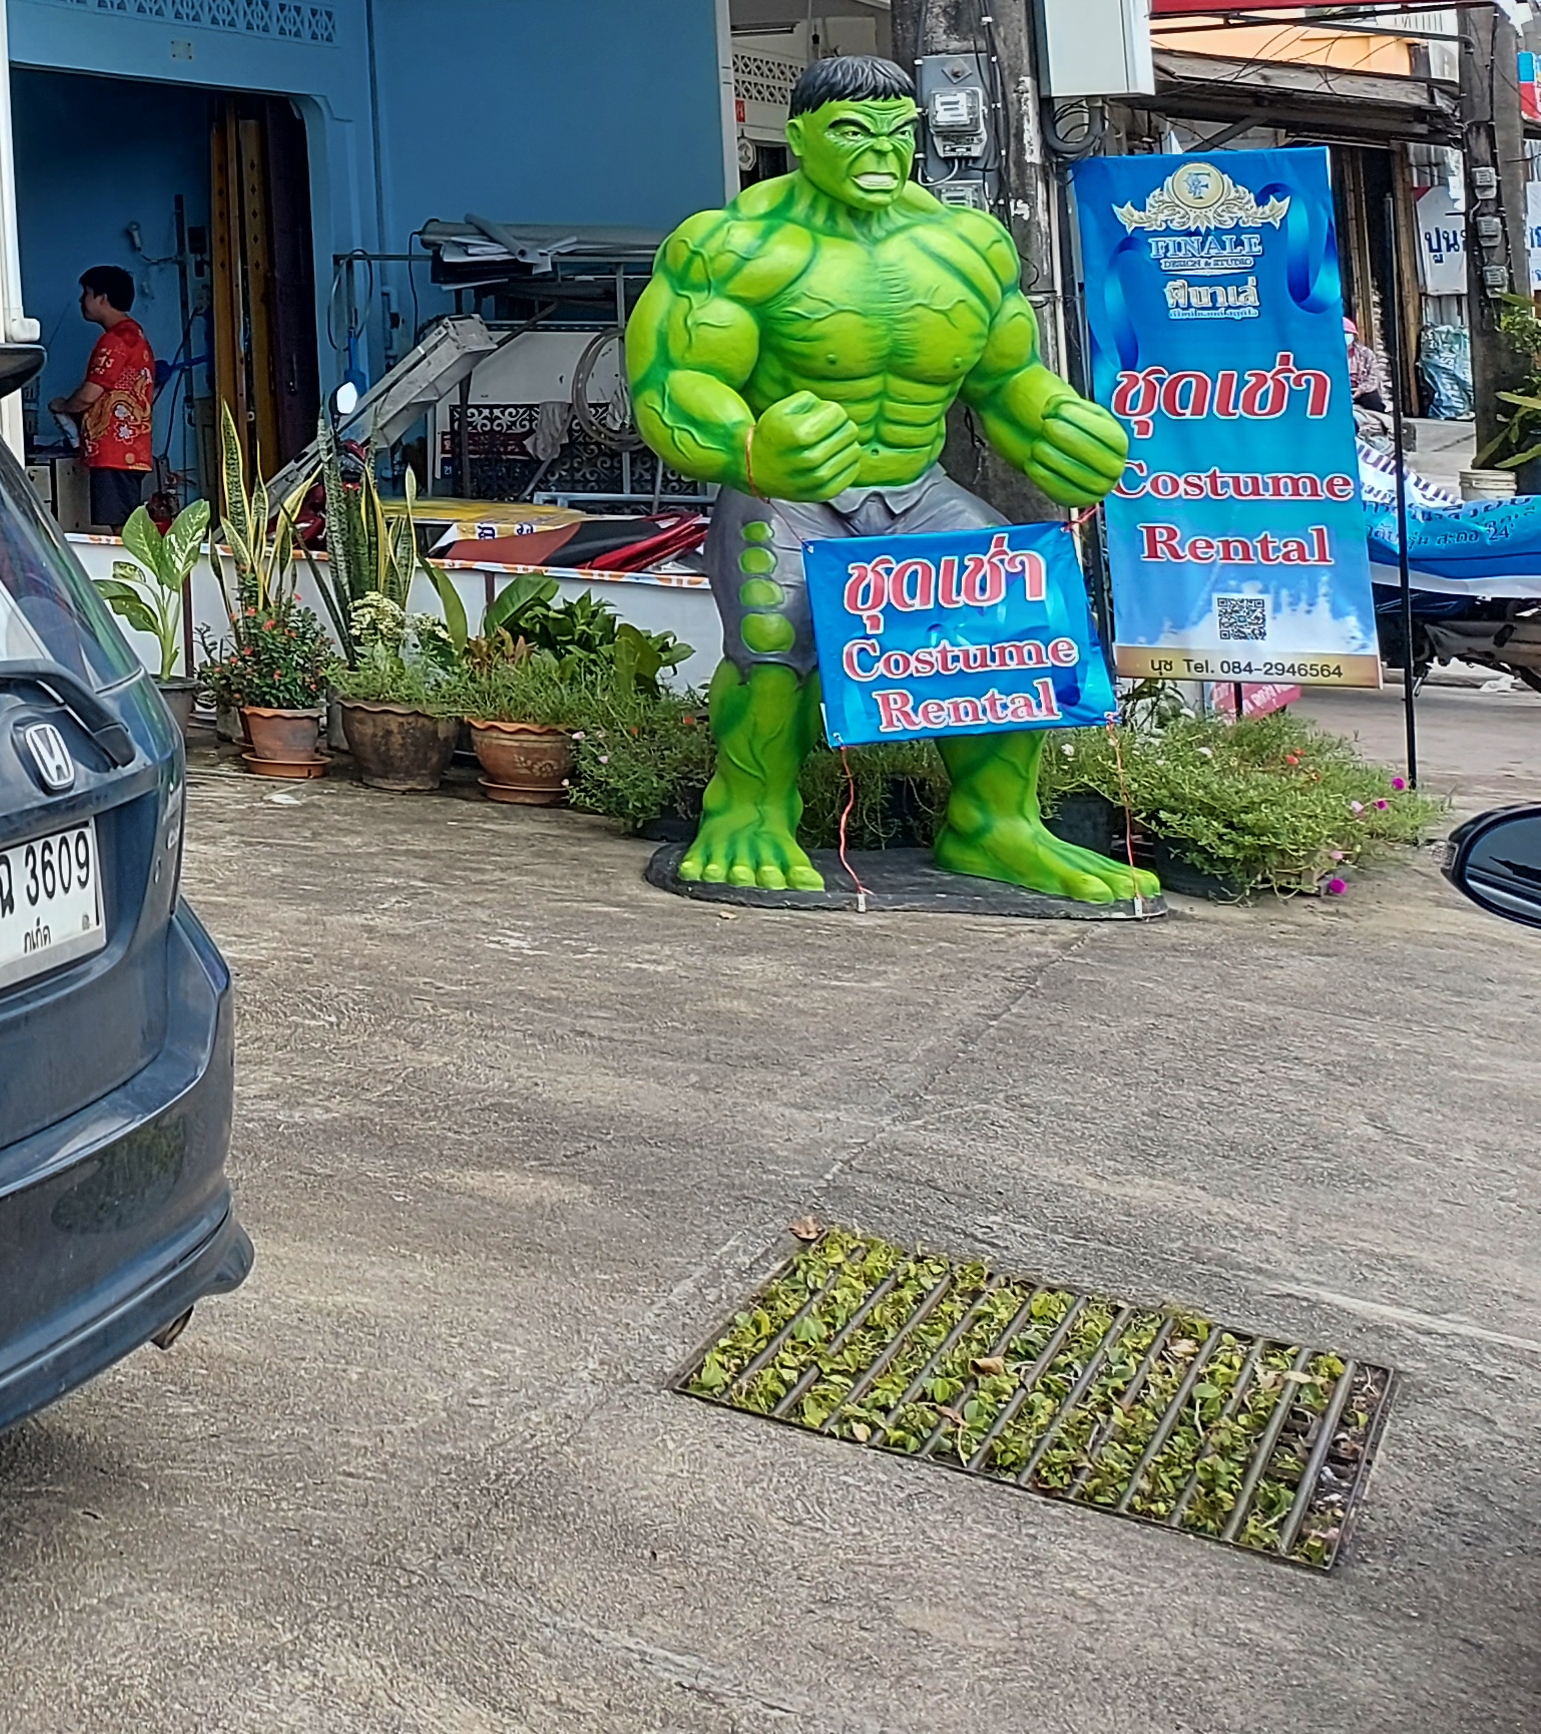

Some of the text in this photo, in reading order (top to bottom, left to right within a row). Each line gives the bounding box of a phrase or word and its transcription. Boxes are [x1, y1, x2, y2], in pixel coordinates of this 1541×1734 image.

[1148, 234, 1263, 259] FINALE
[1111, 352, 1330, 438] ชุดเช่า
[1112, 460, 1354, 501] Costume
[1138, 523, 1335, 566] Rental
[844, 533, 1046, 634] ชุดเช่า
[843, 636, 1080, 682] Costume
[1183, 659, 1214, 674] Tel.
[1220, 660, 1343, 678] 084-2946564
[873, 678, 1062, 732] Rental
[25, 831, 90, 906] 3609
